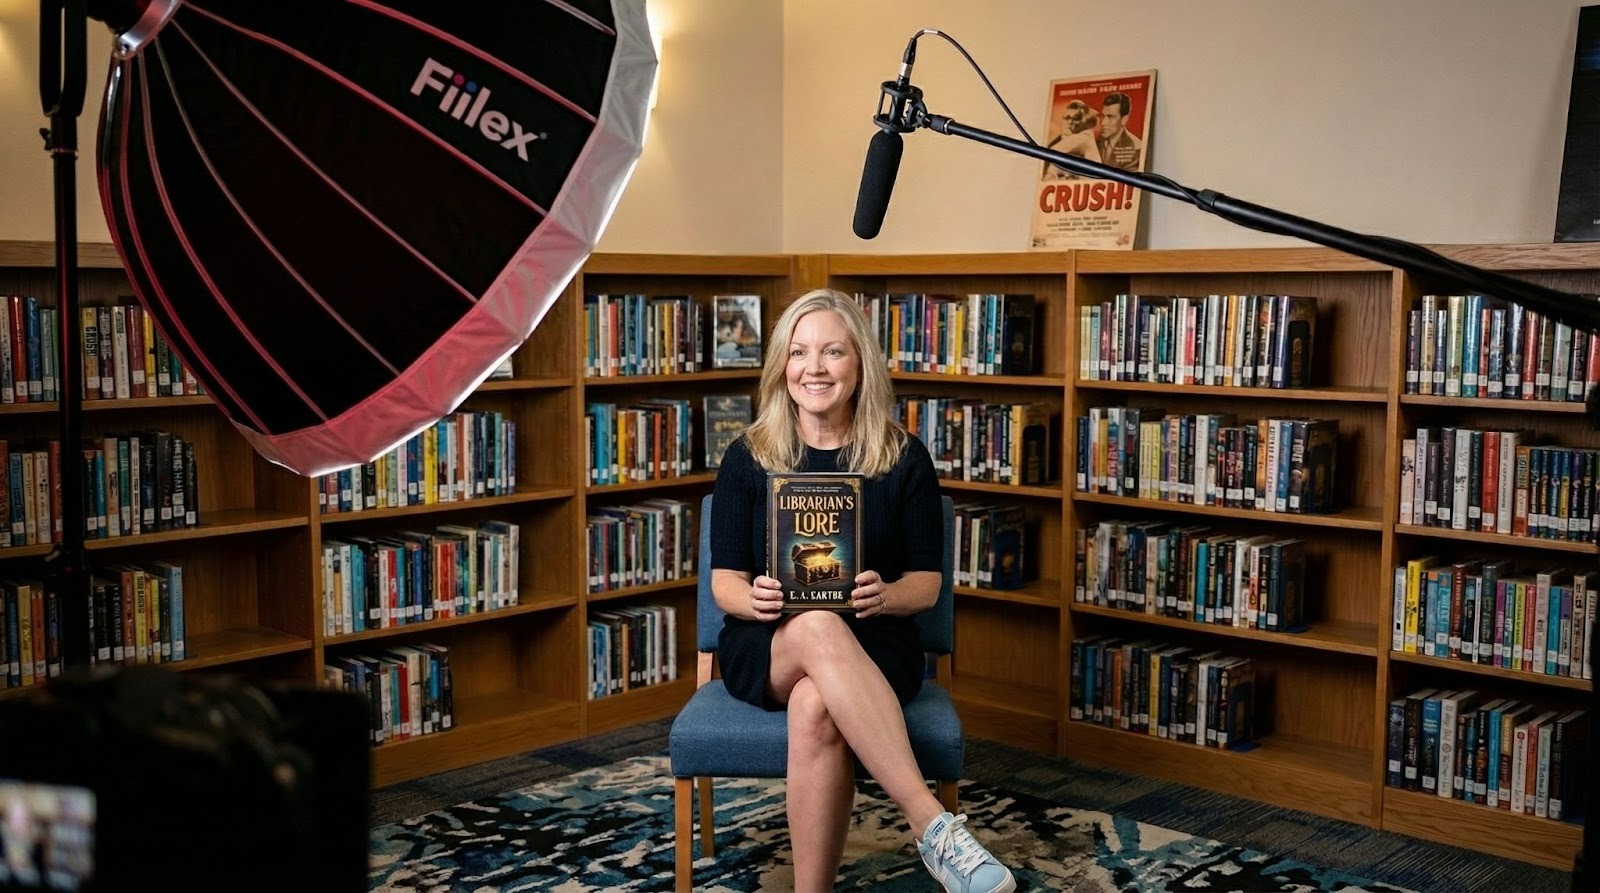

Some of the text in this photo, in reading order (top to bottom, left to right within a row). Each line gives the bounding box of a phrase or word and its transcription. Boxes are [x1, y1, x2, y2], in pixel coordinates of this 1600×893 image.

[410, 57, 539, 162] Fiilex
[1039, 181, 1134, 214] CRUSH!
[780, 495, 854, 512] LIBRARIAN'S
[794, 512, 840, 537] LORE
